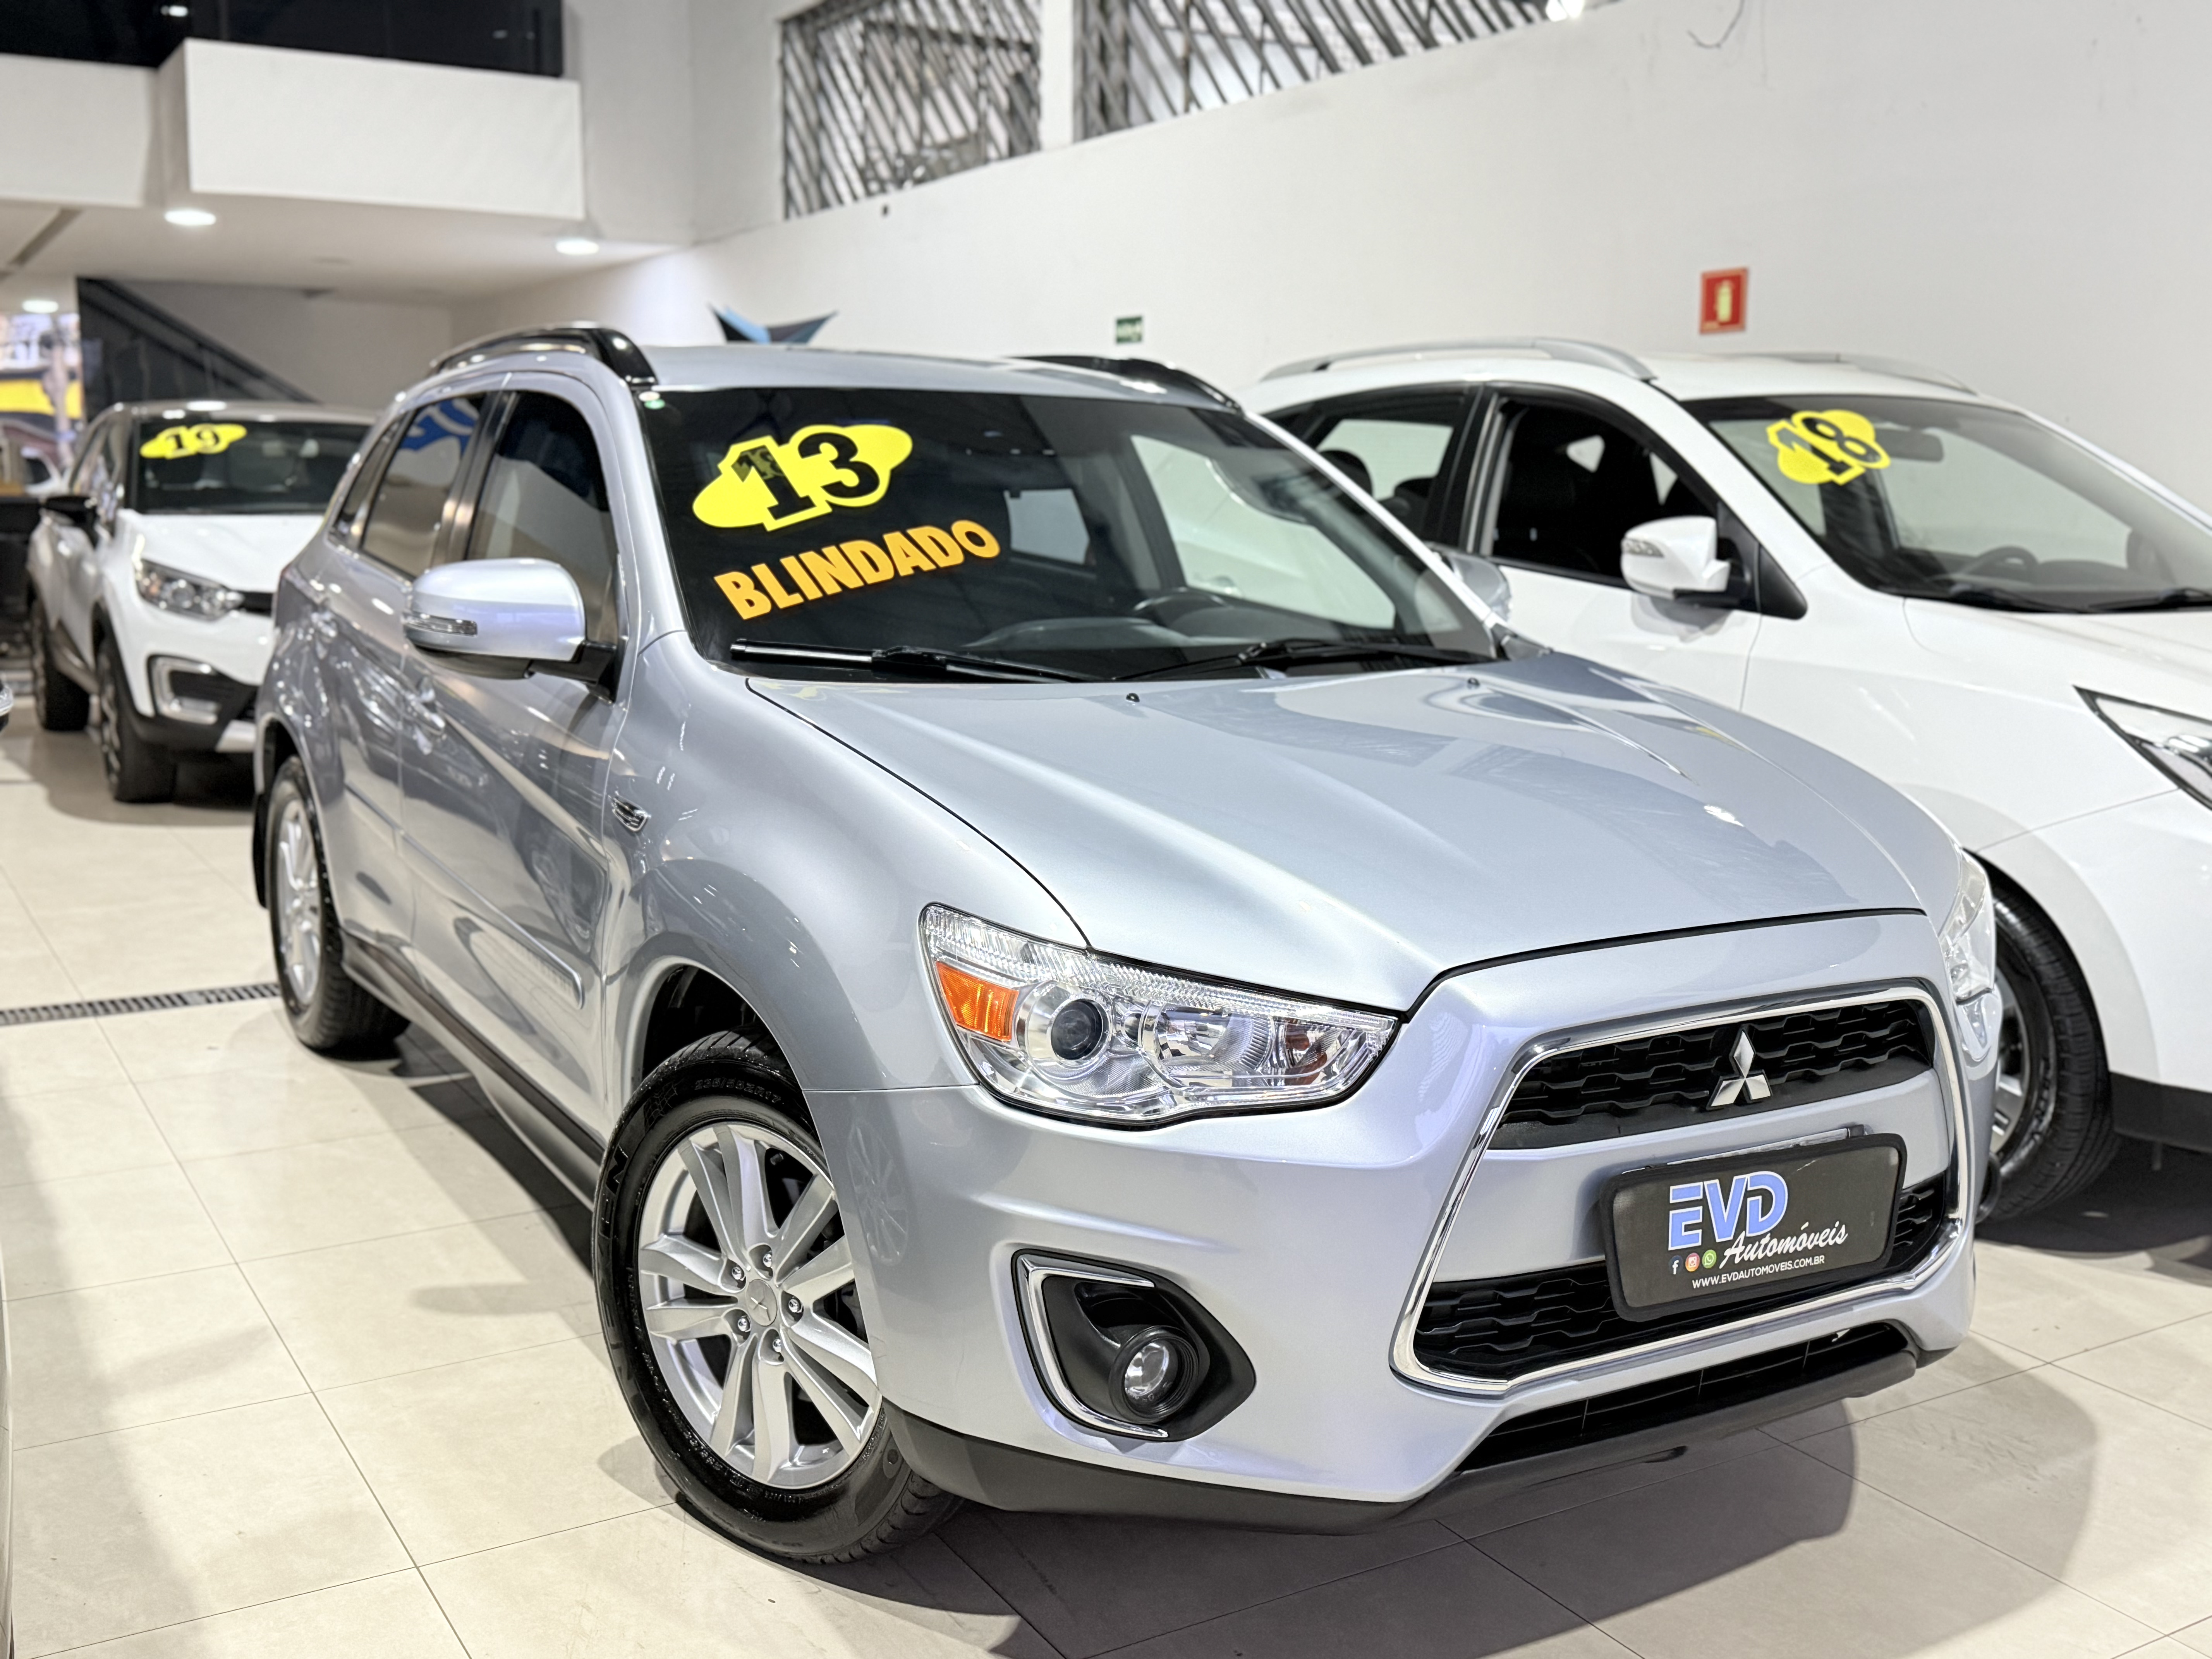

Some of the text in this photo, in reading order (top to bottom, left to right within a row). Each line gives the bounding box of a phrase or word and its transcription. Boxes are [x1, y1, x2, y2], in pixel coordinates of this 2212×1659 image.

[165, 428, 220, 452] 19
[1776, 417, 1881, 476] 18
[731, 432, 880, 520] 13
[714, 520, 1000, 620] BLINDADO
[1668, 1171, 1788, 1250] EVD
[1692, 1255, 1825, 1289] WWW.EVDAUTOMOVEIS.COM.BR
[1719, 1221, 1848, 1269] Automóveis
